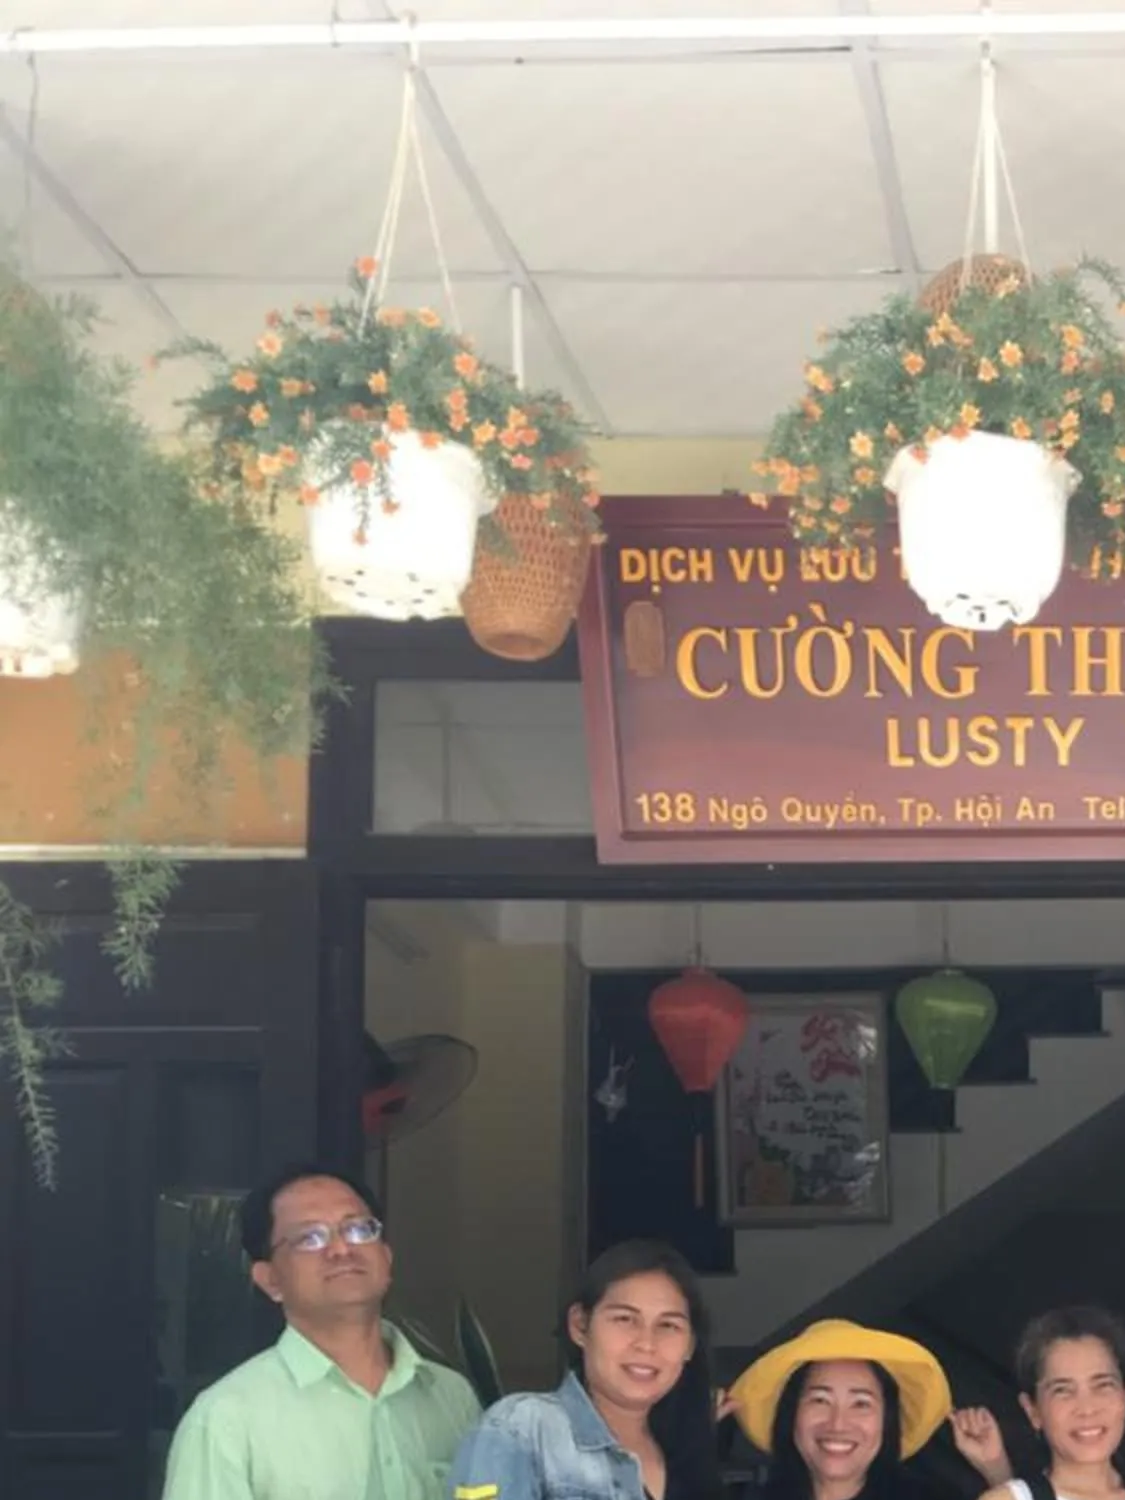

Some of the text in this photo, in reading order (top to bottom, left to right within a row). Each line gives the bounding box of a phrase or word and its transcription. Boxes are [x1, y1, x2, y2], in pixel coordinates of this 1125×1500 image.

[619, 547, 715, 593] DỊCH
[728, 547, 785, 593] VỤ
[675, 602, 980, 700] CƯỜNG
[886, 715, 1085, 768] LUSTY
[635, 792, 697, 823] 138
[708, 797, 769, 831] Ngô
[897, 798, 943, 828] Tp.
[954, 794, 1002, 827] Hội
[1015, 797, 1055, 821] An
